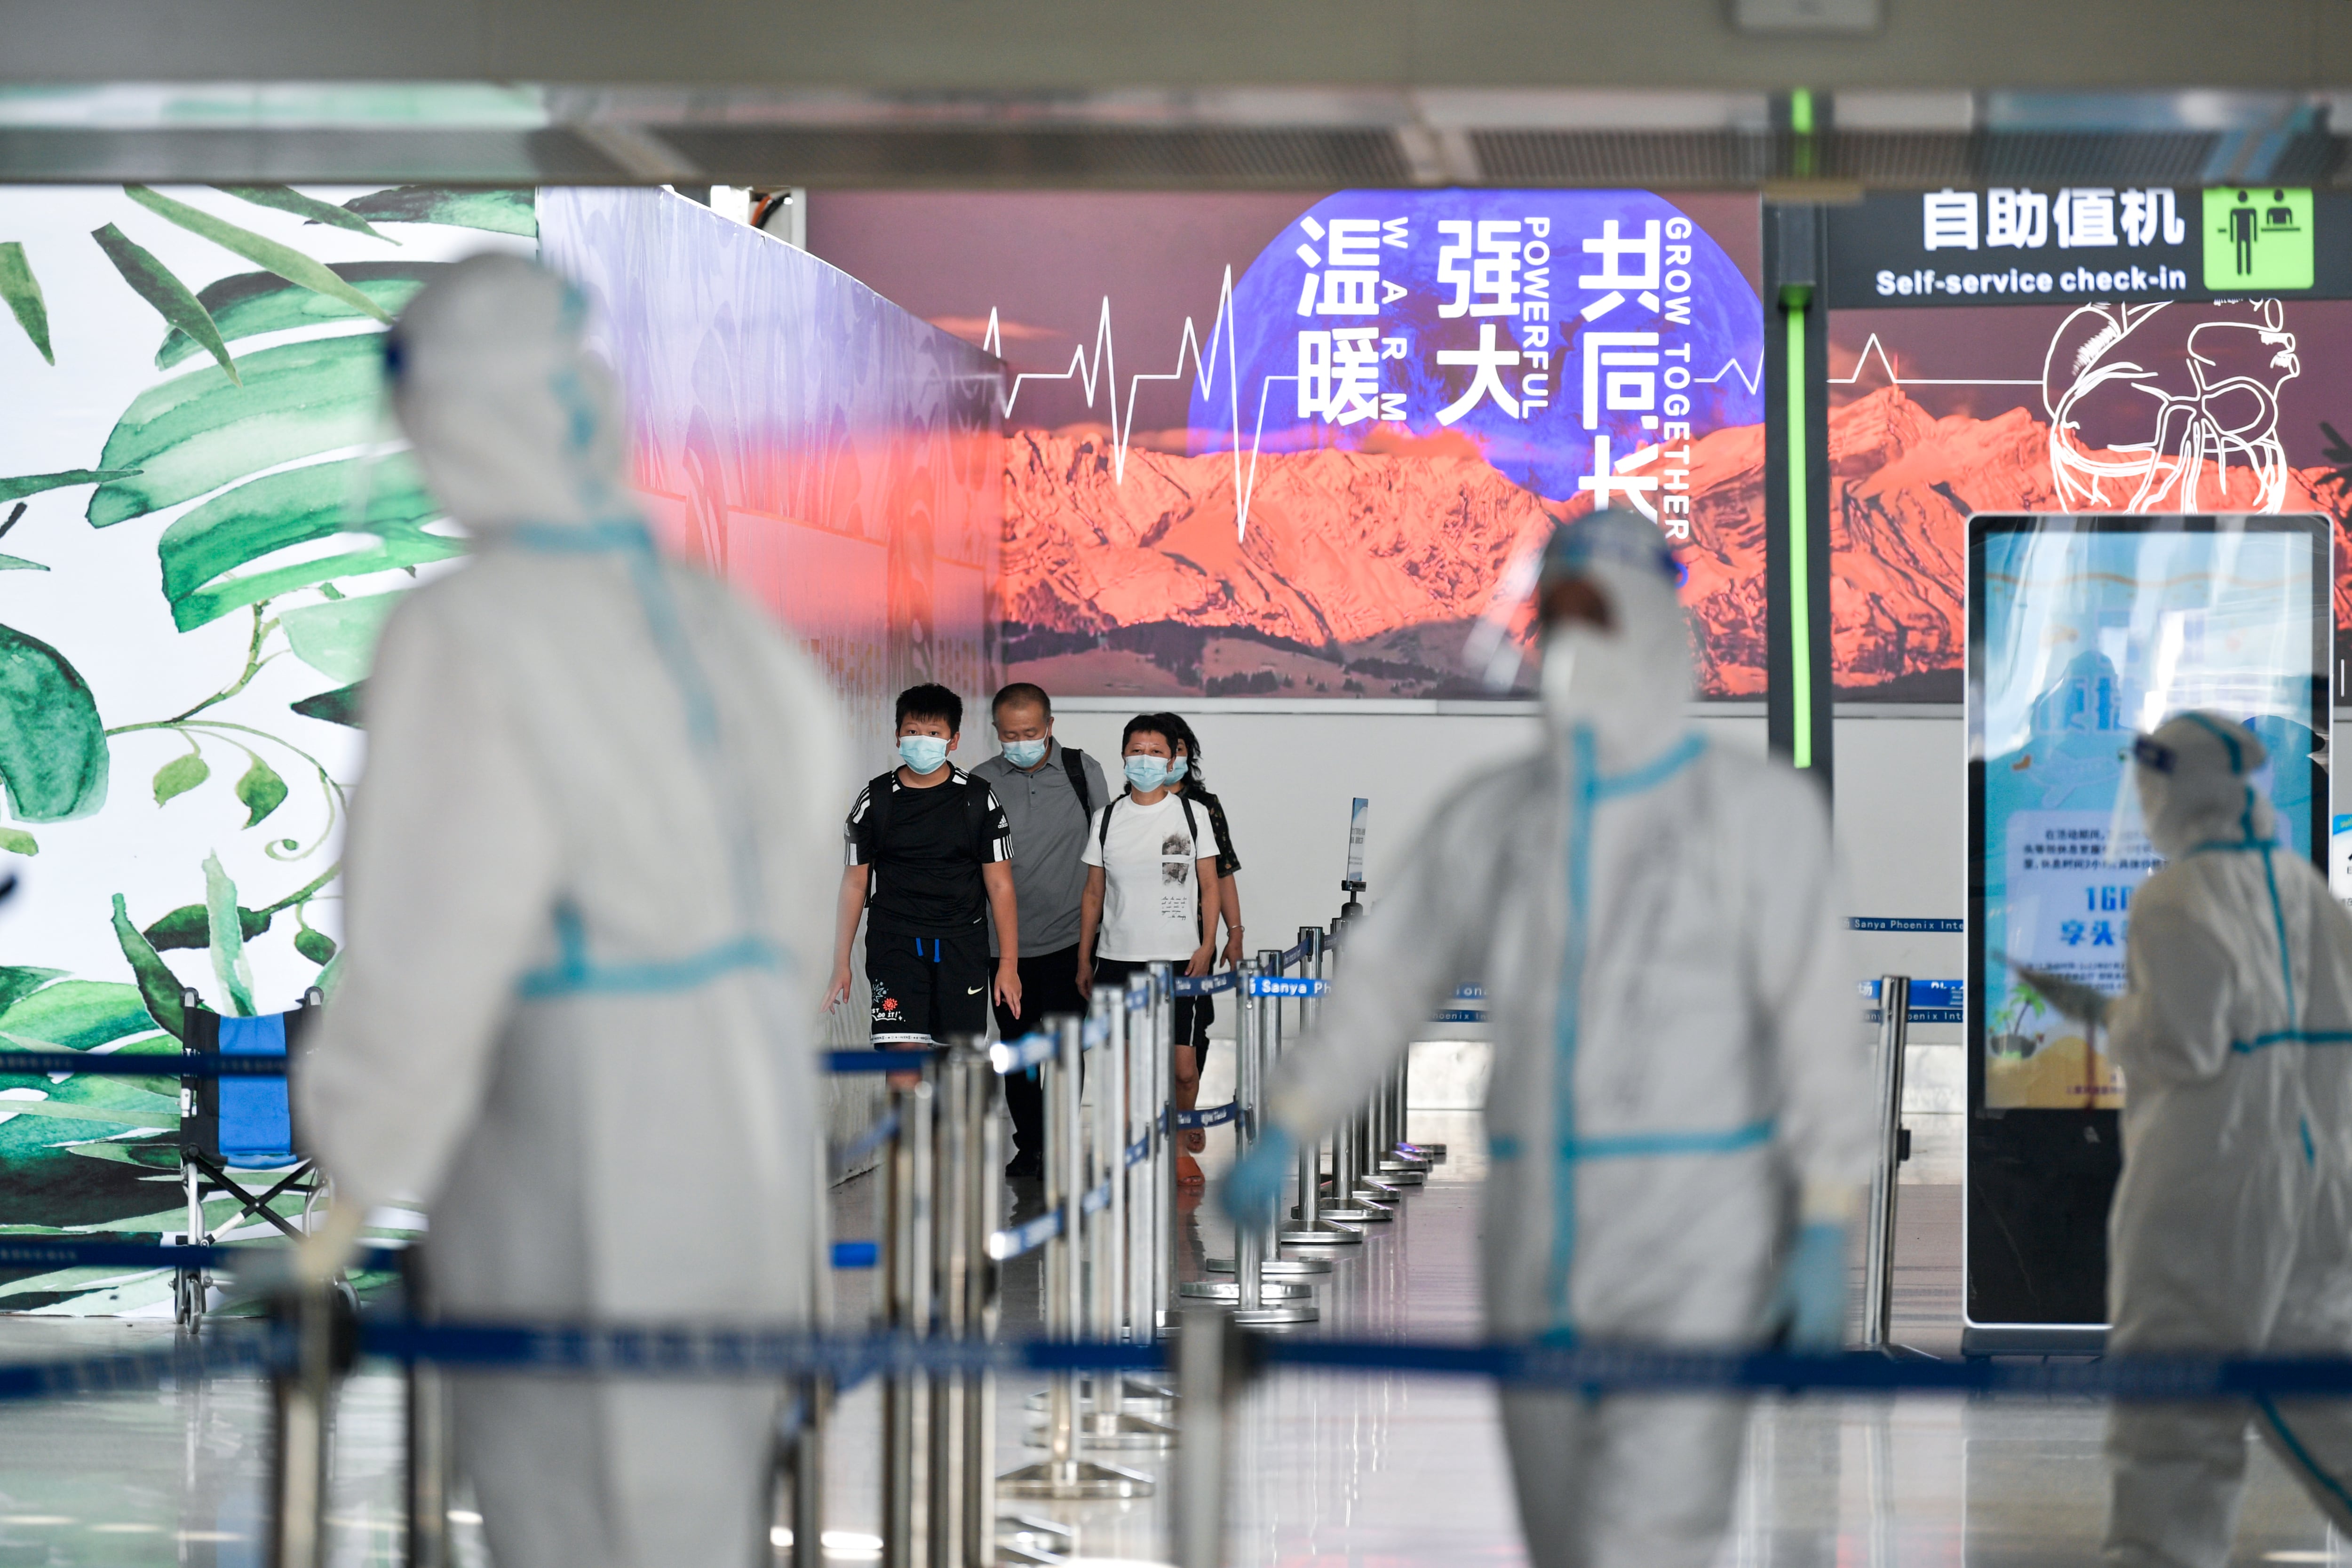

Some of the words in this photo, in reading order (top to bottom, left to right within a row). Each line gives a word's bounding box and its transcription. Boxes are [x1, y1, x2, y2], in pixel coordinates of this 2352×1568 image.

[1665, 217, 1692, 326] GROW
[1923, 189, 2186, 251] 自助值机
[1295, 215, 1380, 426] 温暖
[1381, 217, 1409, 422] WARM
[1435, 220, 1522, 427] 强大
[1522, 217, 1551, 420] POWERFUL
[1876, 268, 2054, 296] Self-service
[2060, 265, 2187, 292] check-in
[1664, 342, 1691, 541] TOGETHER
[1855, 919, 1886, 930] Sanya
[1891, 920, 1934, 930] Phoenix
[1262, 979, 1307, 996] Sanya
[1907, 1012, 1938, 1020] oenix
